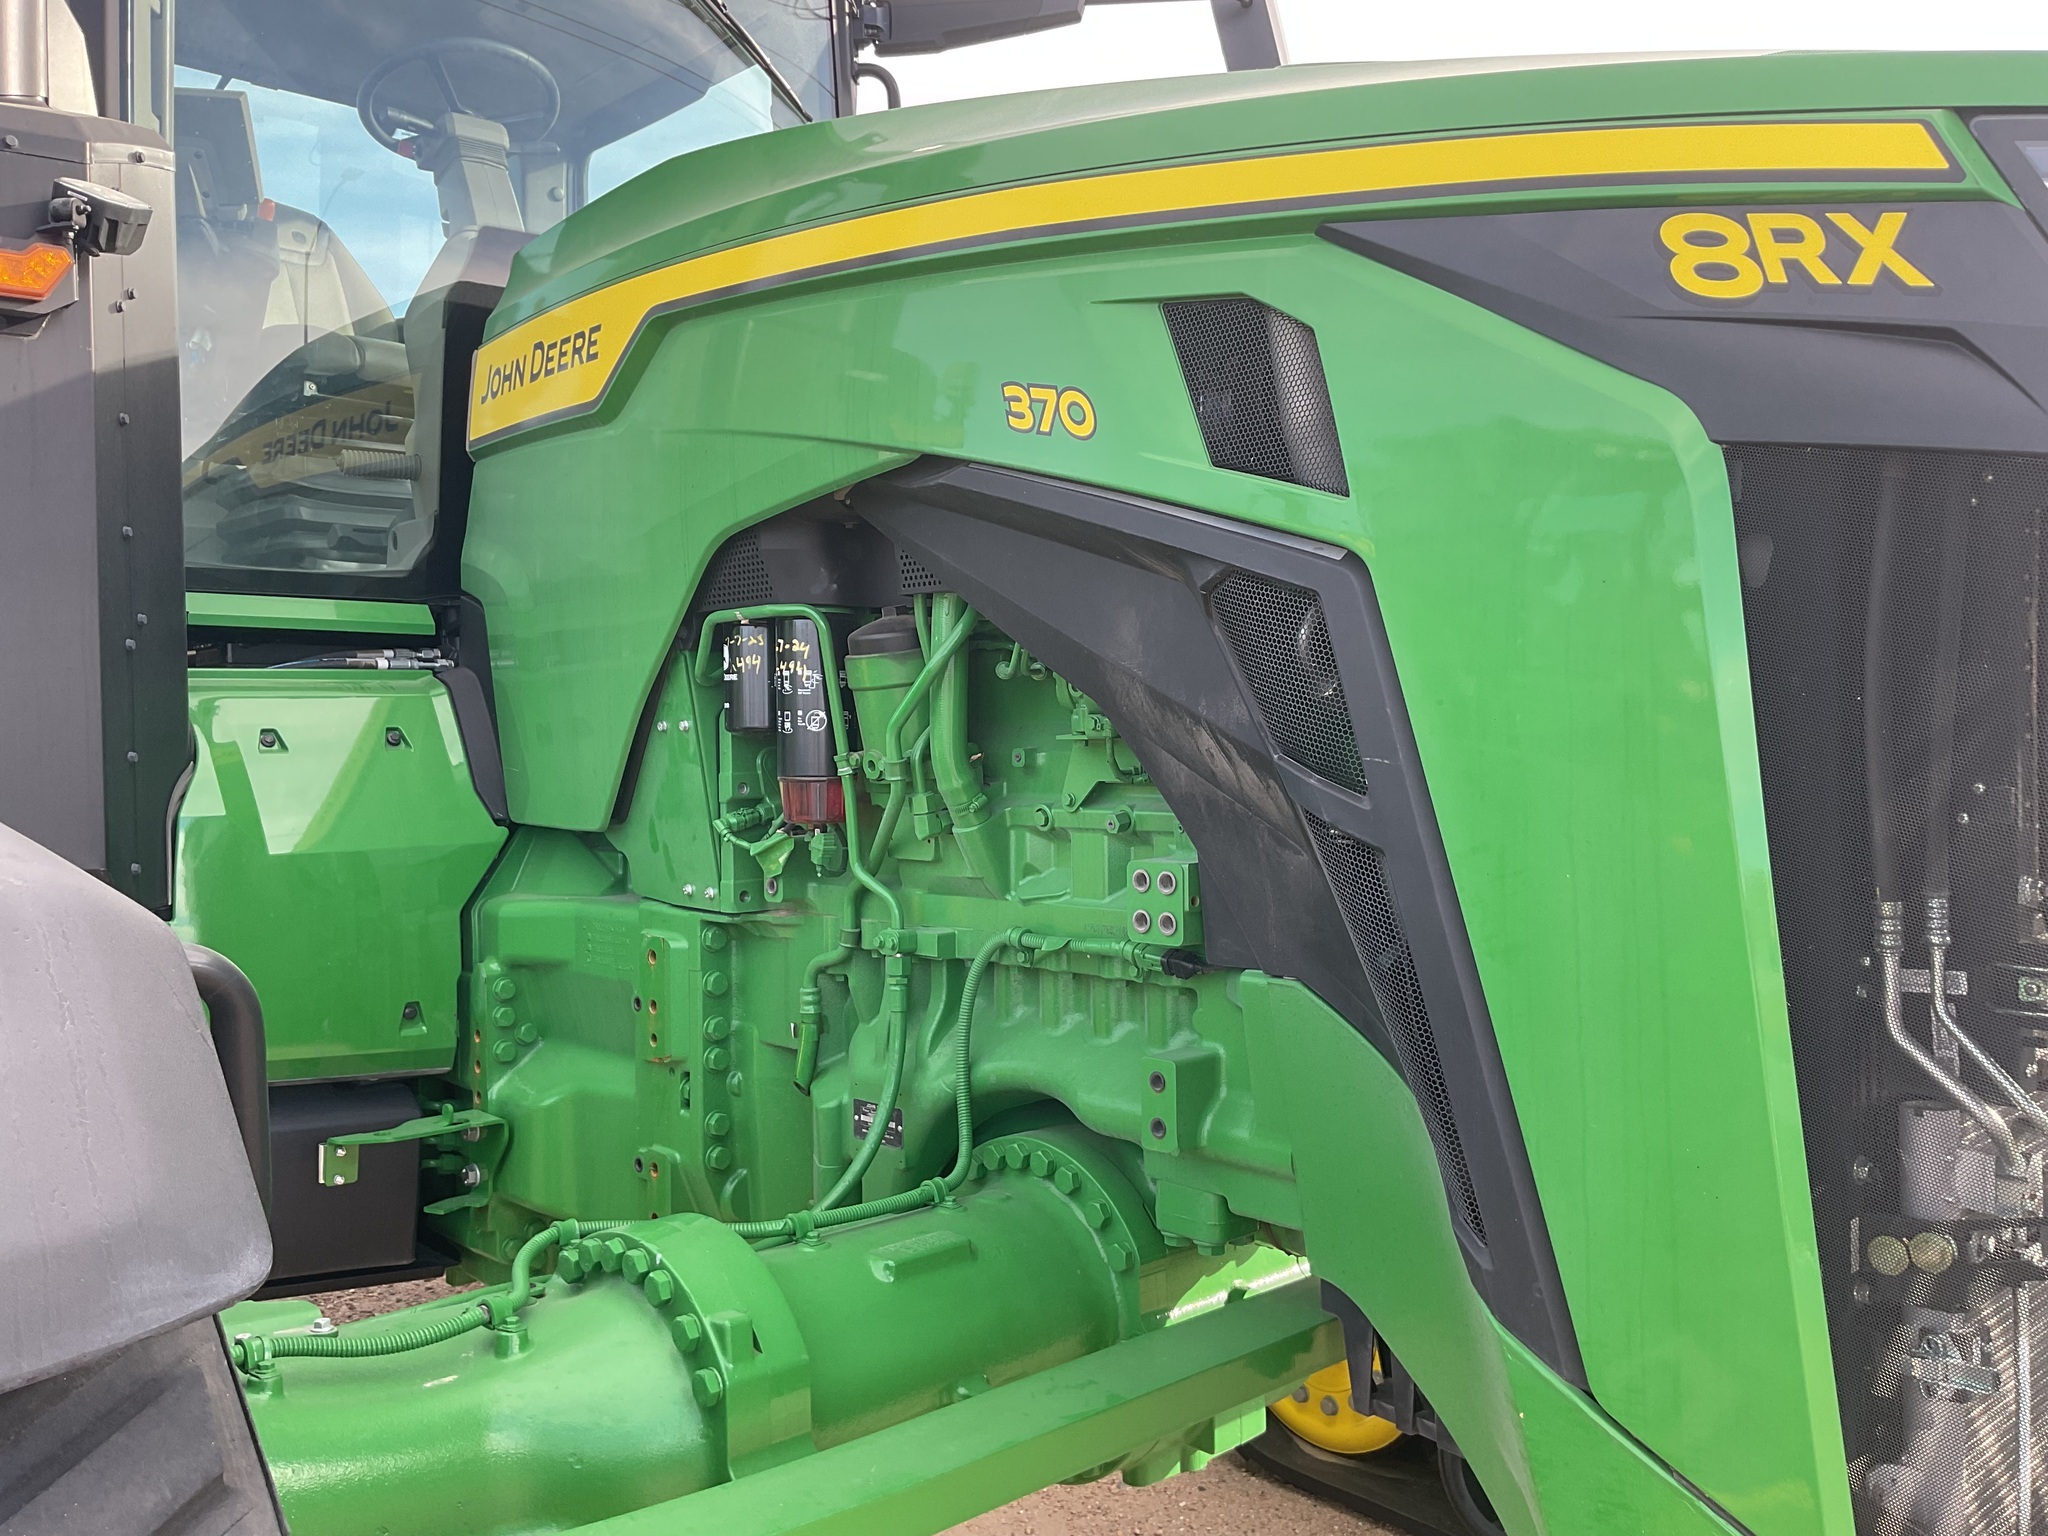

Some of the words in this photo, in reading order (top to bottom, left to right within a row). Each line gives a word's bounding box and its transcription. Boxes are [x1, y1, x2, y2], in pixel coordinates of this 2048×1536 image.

[1660, 212, 1935, 298] 8RX
[481, 354, 527, 405] JOHN
[529, 323, 602, 384] DEERE
[1001, 381, 1097, 441] 370
